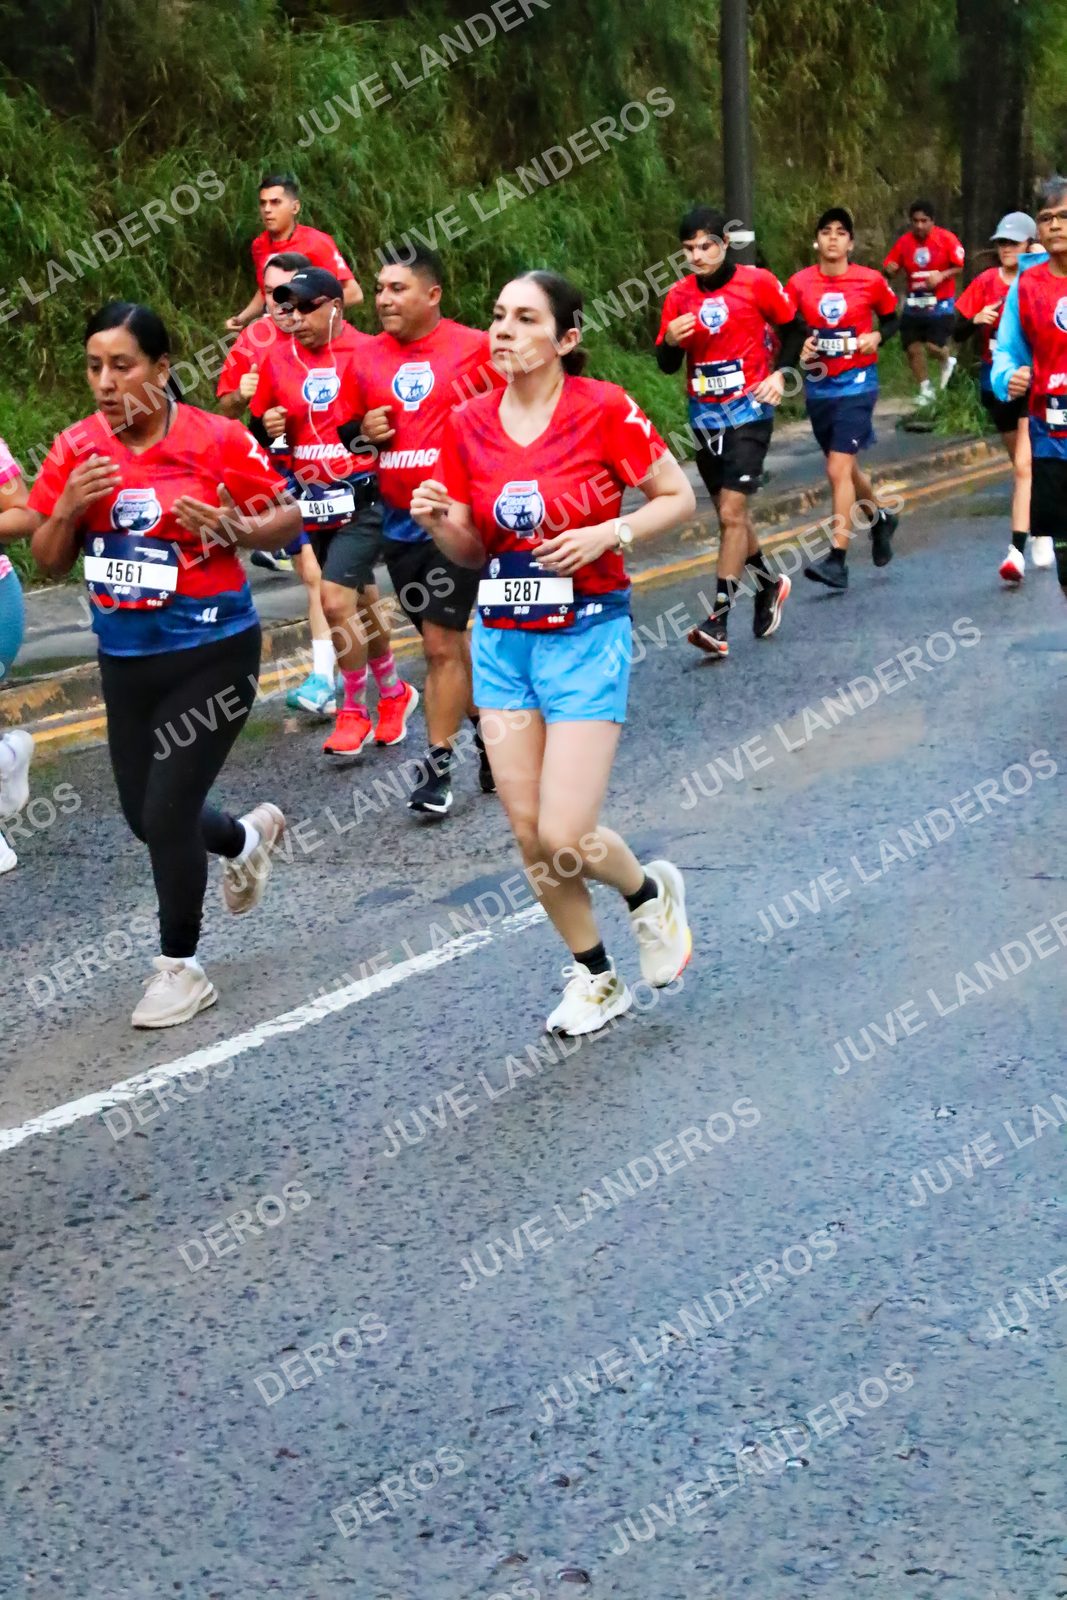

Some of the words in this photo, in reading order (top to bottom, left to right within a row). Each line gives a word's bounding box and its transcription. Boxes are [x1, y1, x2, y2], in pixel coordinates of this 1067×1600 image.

[379, 448, 441, 470] SANTIAG
[308, 502, 334, 515] 4876
[106, 561, 143, 584] 4561
[504, 580, 541, 603] 5287
